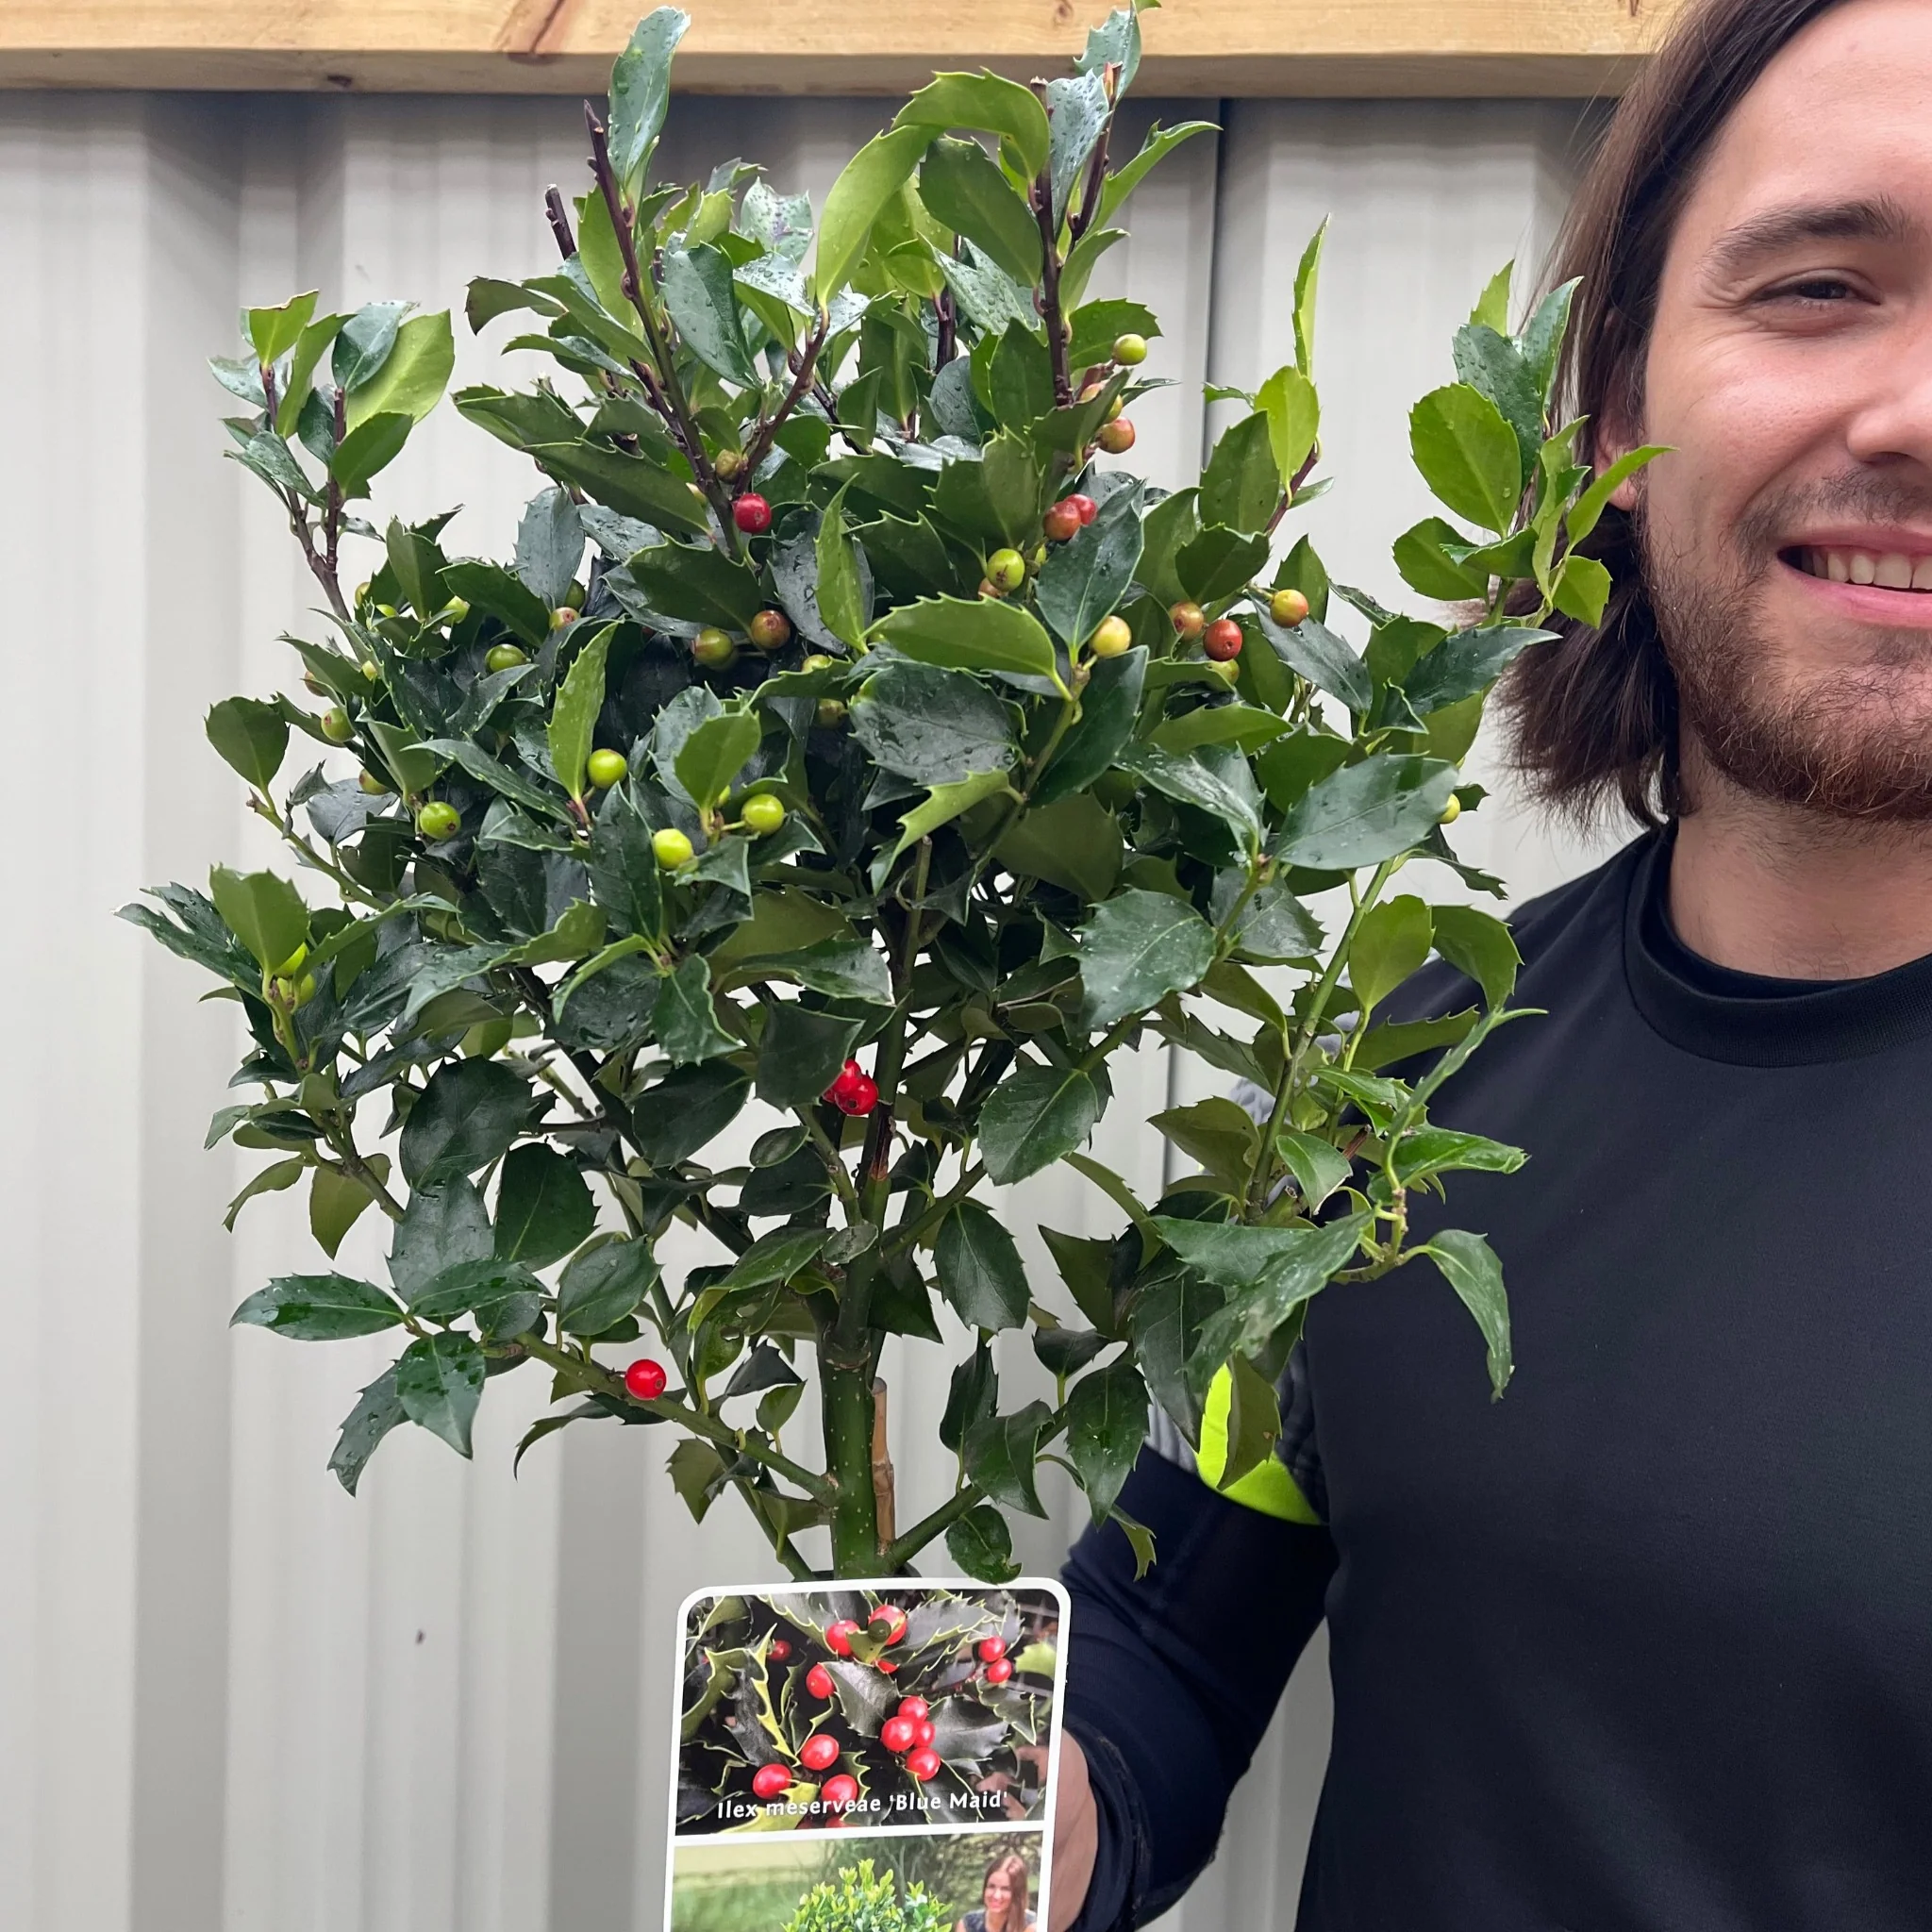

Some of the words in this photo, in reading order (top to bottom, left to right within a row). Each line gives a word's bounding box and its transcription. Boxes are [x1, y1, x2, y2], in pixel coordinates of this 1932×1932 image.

[718, 1801, 757, 1819] Ilex
[766, 1799, 881, 1817] meserveae
[890, 1793, 941, 1811] 'Blue
[949, 1790, 1008, 1809] Maid'
